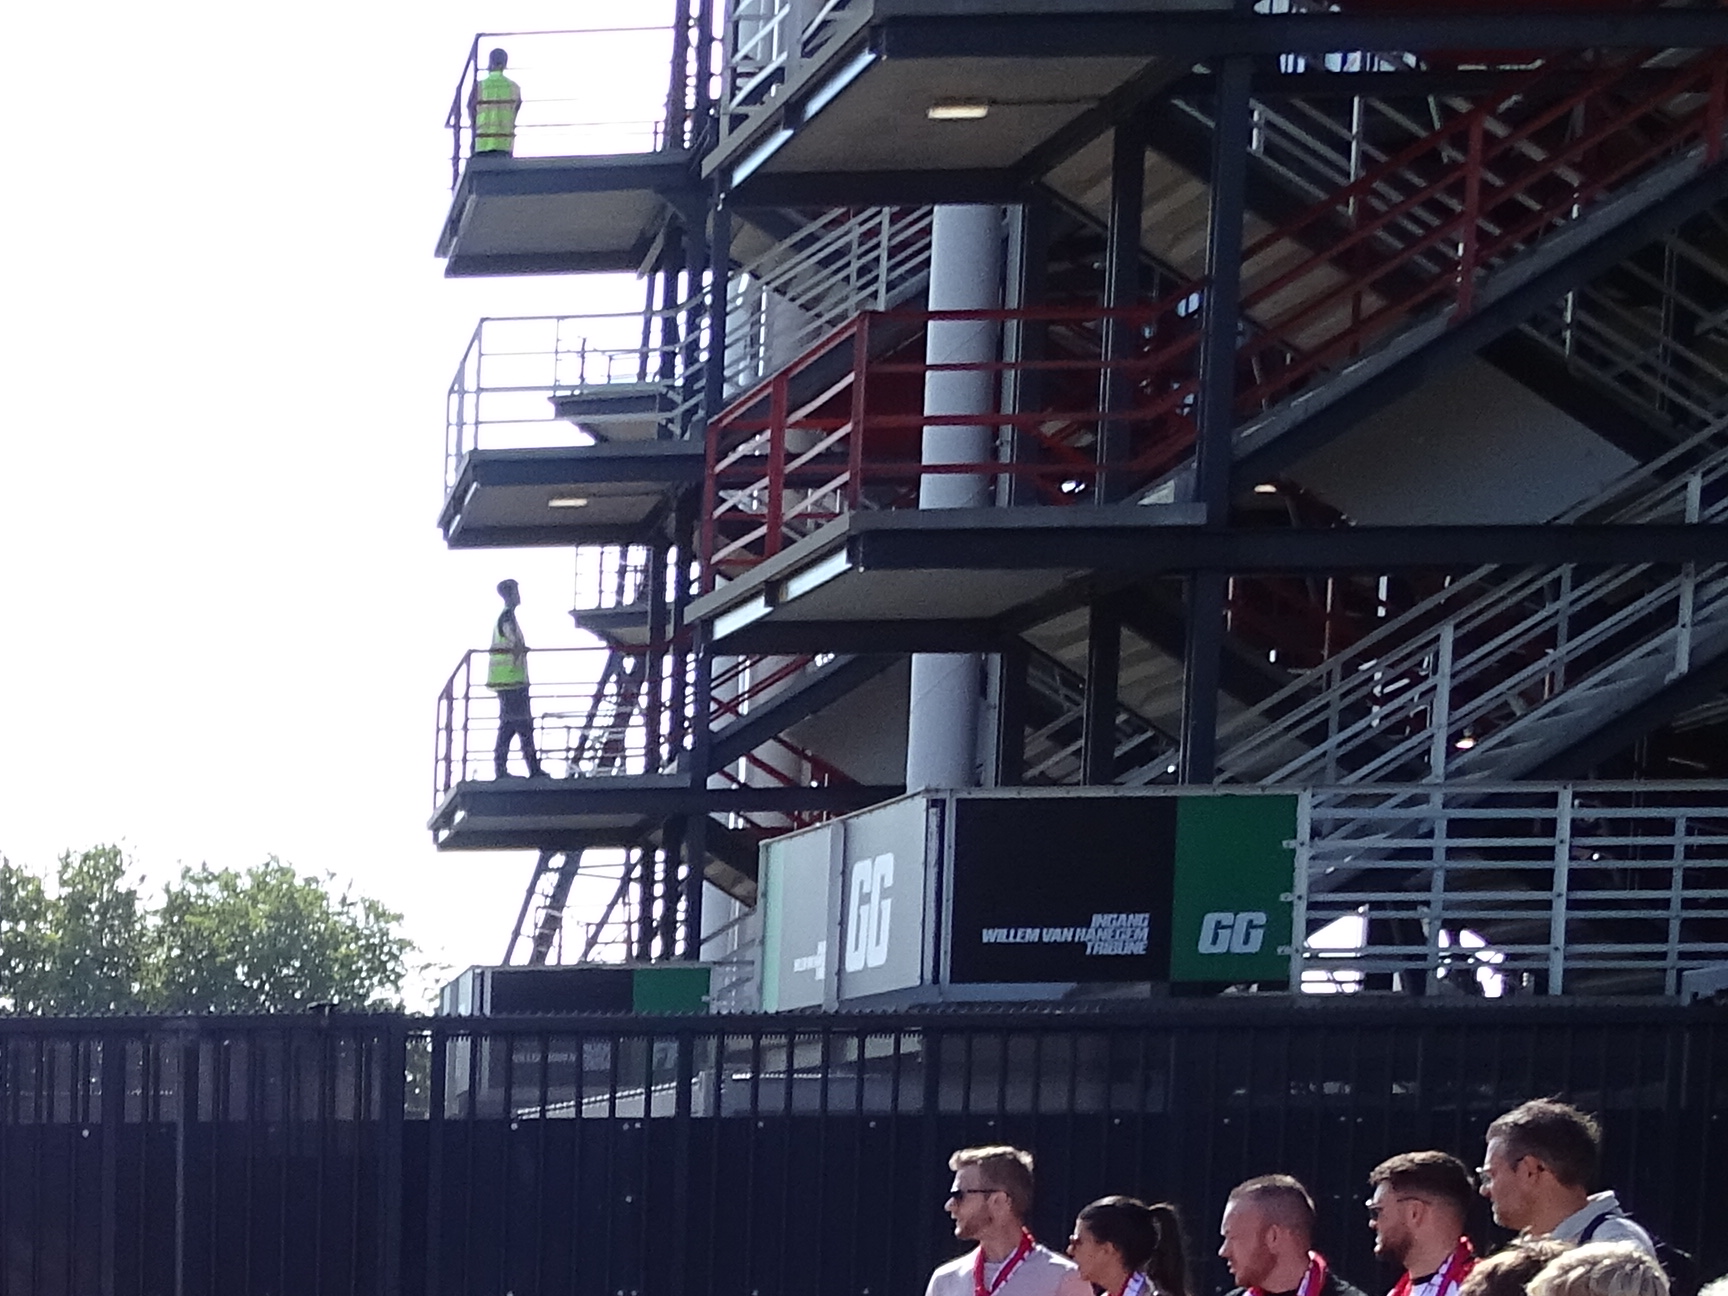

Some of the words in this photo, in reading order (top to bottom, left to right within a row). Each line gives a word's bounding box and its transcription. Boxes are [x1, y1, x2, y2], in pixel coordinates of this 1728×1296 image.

[845, 852, 894, 973] GG
[1090, 913, 1150, 928] INGANG
[982, 928, 1040, 943] WILLEM
[1042, 927, 1074, 942] VAN
[1197, 911, 1267, 954] GG
[1085, 941, 1147, 955] TRIBUNE
